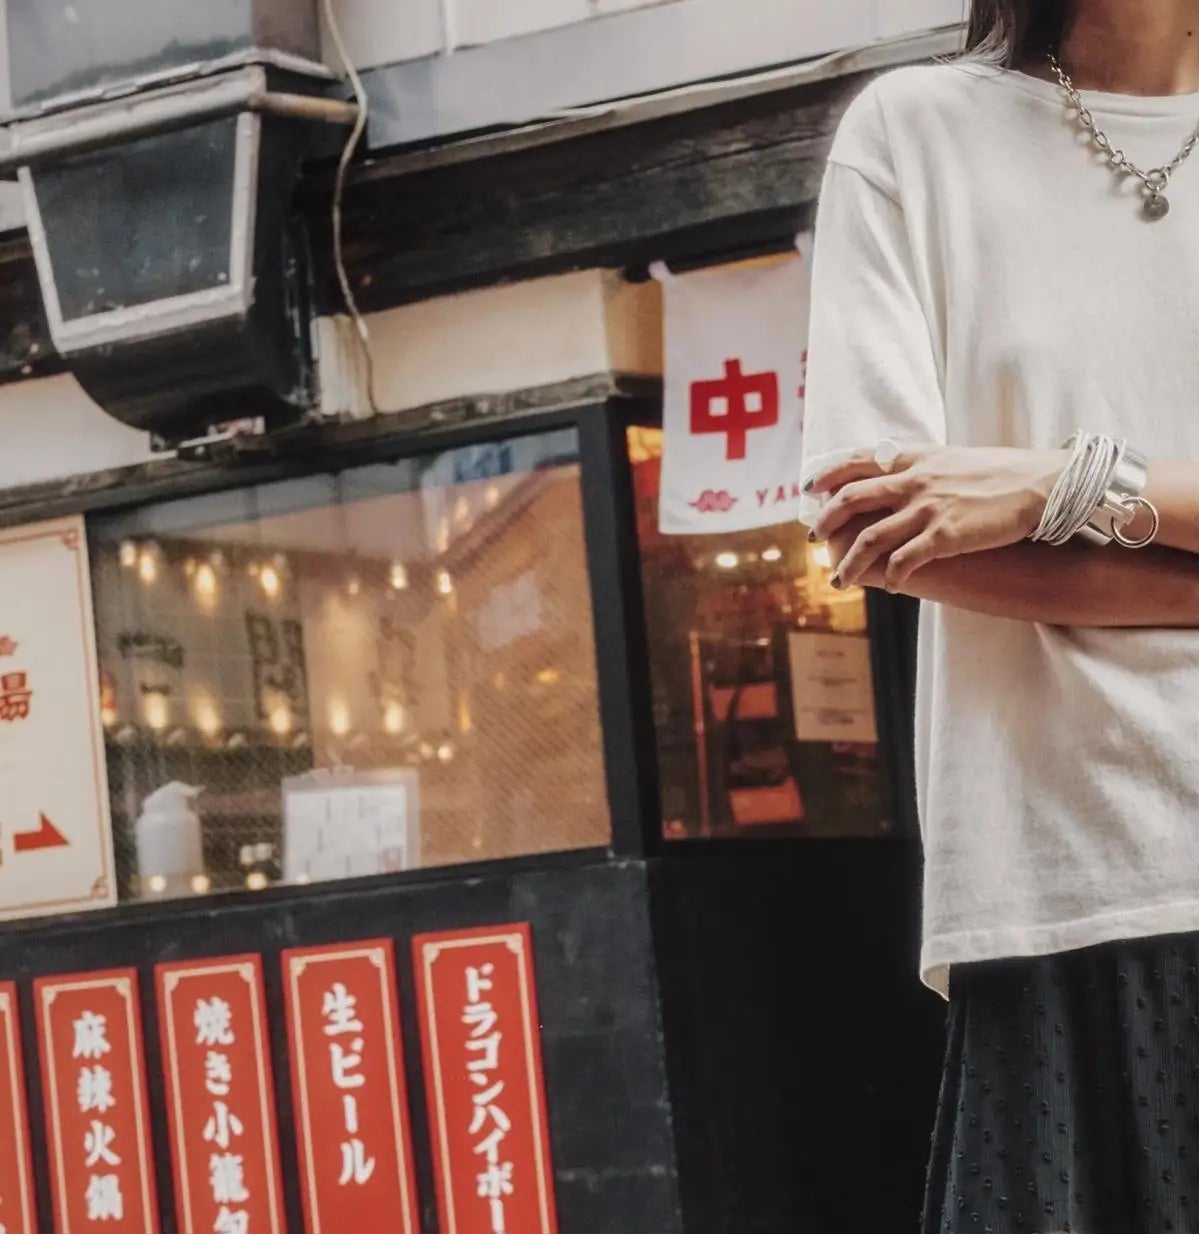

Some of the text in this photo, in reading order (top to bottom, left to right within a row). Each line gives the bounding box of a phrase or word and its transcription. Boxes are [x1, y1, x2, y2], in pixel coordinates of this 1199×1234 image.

[688, 357, 780, 461] 中
[72, 1011, 123, 1221] 麻辣火鍋
[322, 983, 375, 1186] 生ビール
